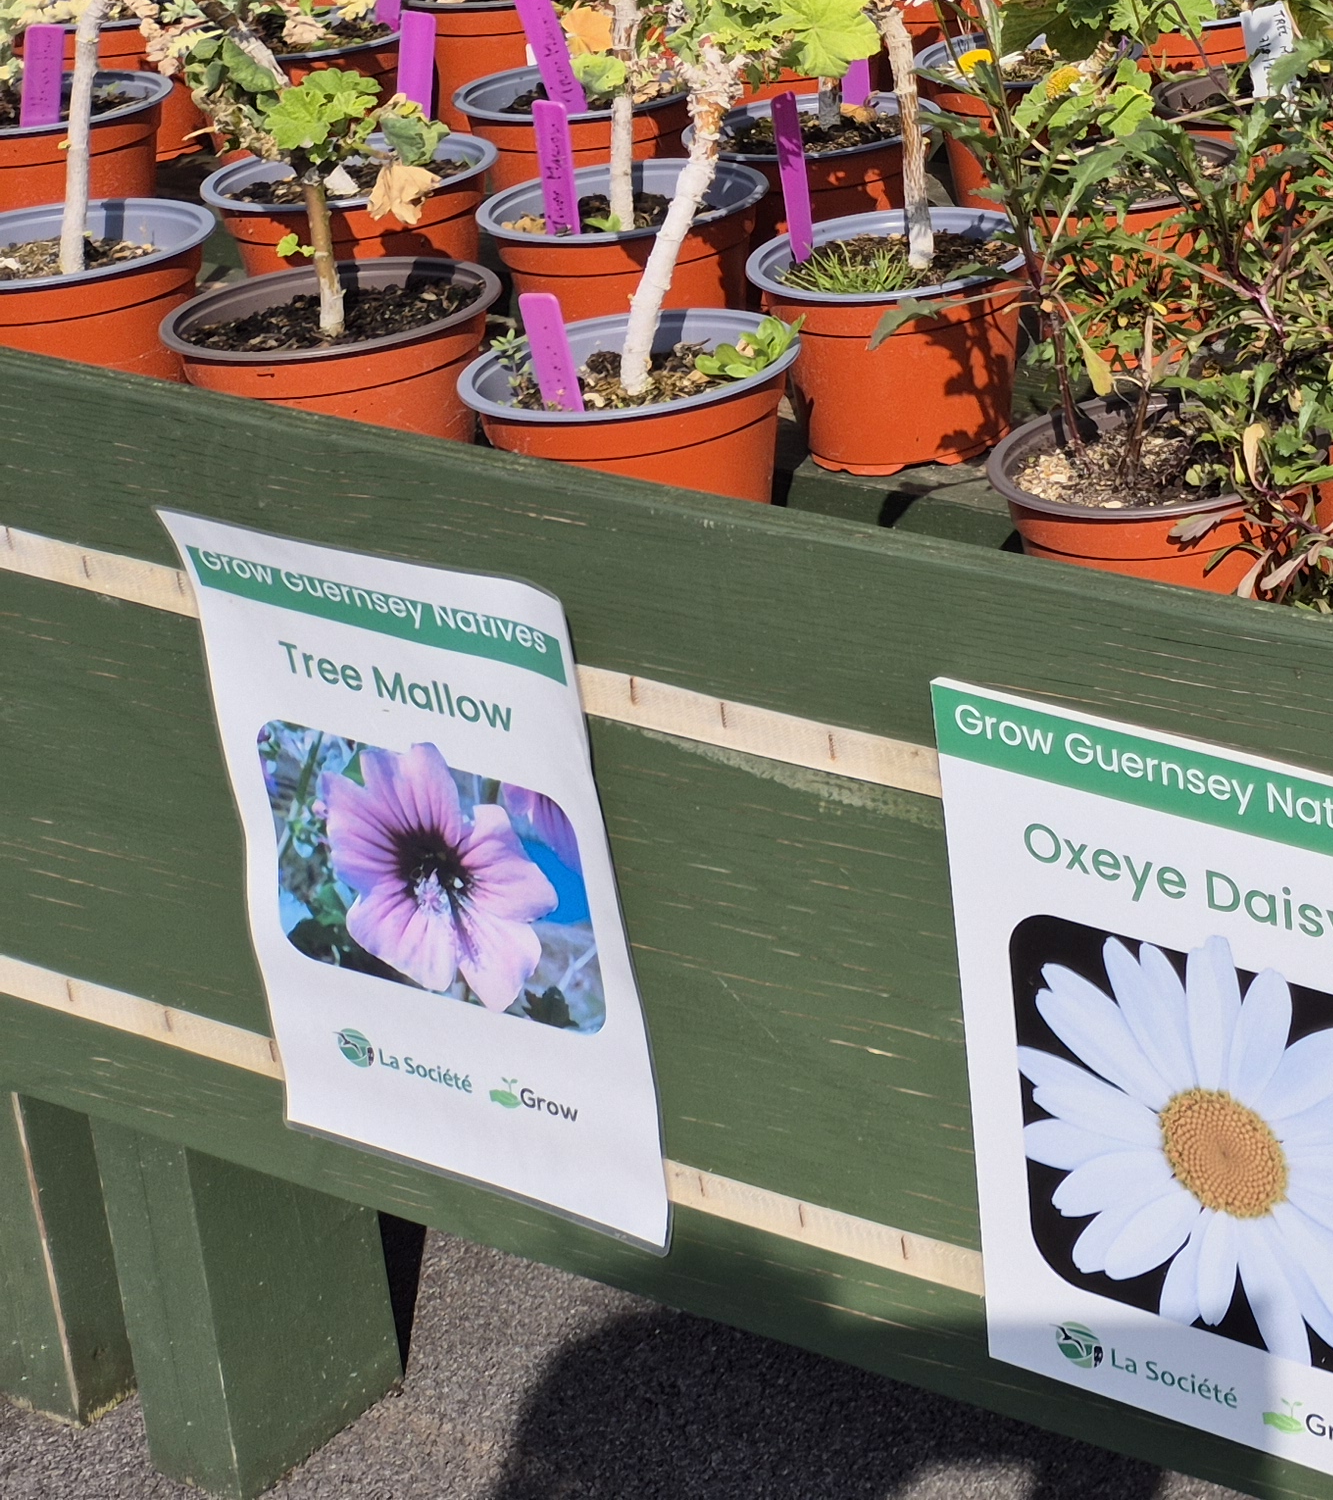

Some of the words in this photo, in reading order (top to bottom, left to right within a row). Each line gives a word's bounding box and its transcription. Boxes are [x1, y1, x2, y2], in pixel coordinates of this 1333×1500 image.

[200, 548, 273, 586] Grow
[280, 569, 422, 630] Guernsey
[431, 604, 548, 654] Natives
[278, 640, 363, 692] Tree
[372, 665, 512, 732] Mallow
[954, 704, 1054, 754] Grow
[1064, 733, 1254, 816] Guernsey
[1024, 822, 1188, 903] Oxeye
[378, 1047, 400, 1070] La
[404, 1054, 473, 1095] Société
[520, 1087, 579, 1123] Grow
[1111, 1346, 1137, 1374] La
[1145, 1352, 1238, 1409] Société
